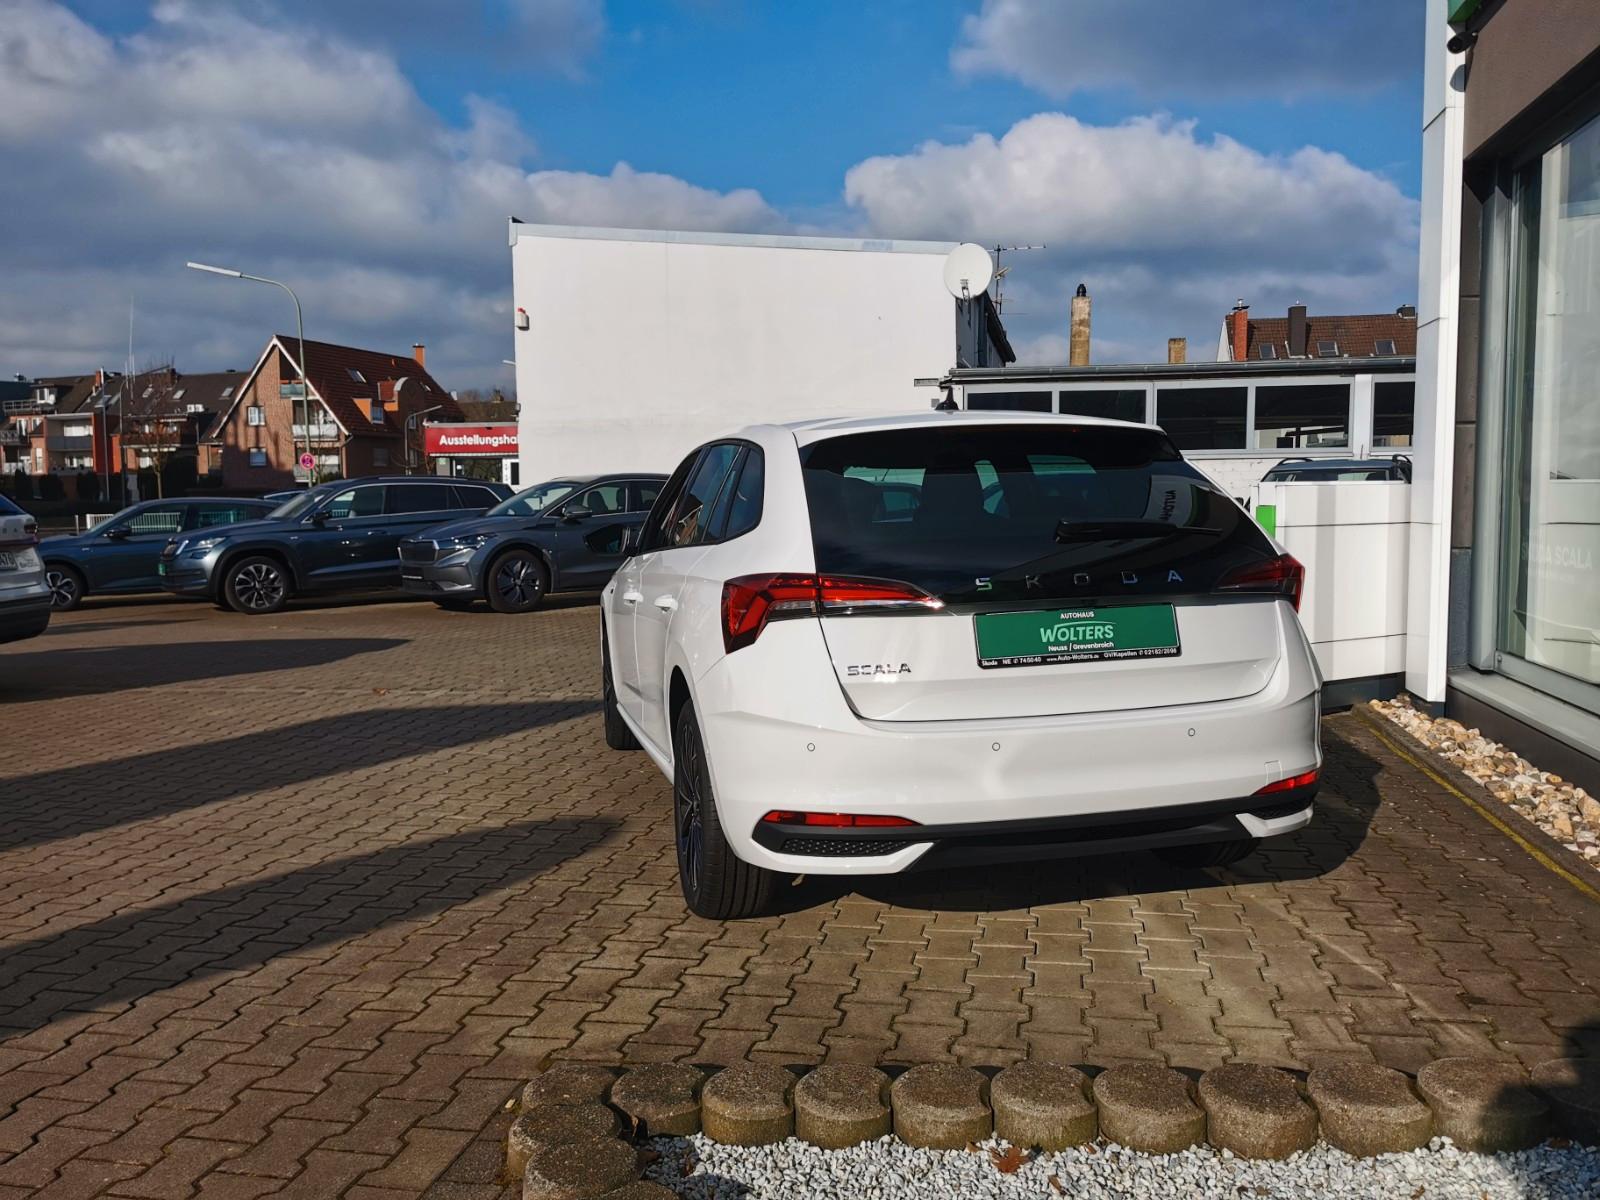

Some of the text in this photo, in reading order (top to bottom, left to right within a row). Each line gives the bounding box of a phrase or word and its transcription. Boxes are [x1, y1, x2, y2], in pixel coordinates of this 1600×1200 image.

[1060, 611, 1095, 620] AUTOHAUS
[1039, 623, 1115, 643] WOLTERS
[1048, 641, 1115, 652] Neuss Grevenbroich
[847, 663, 912, 676] SCALA
